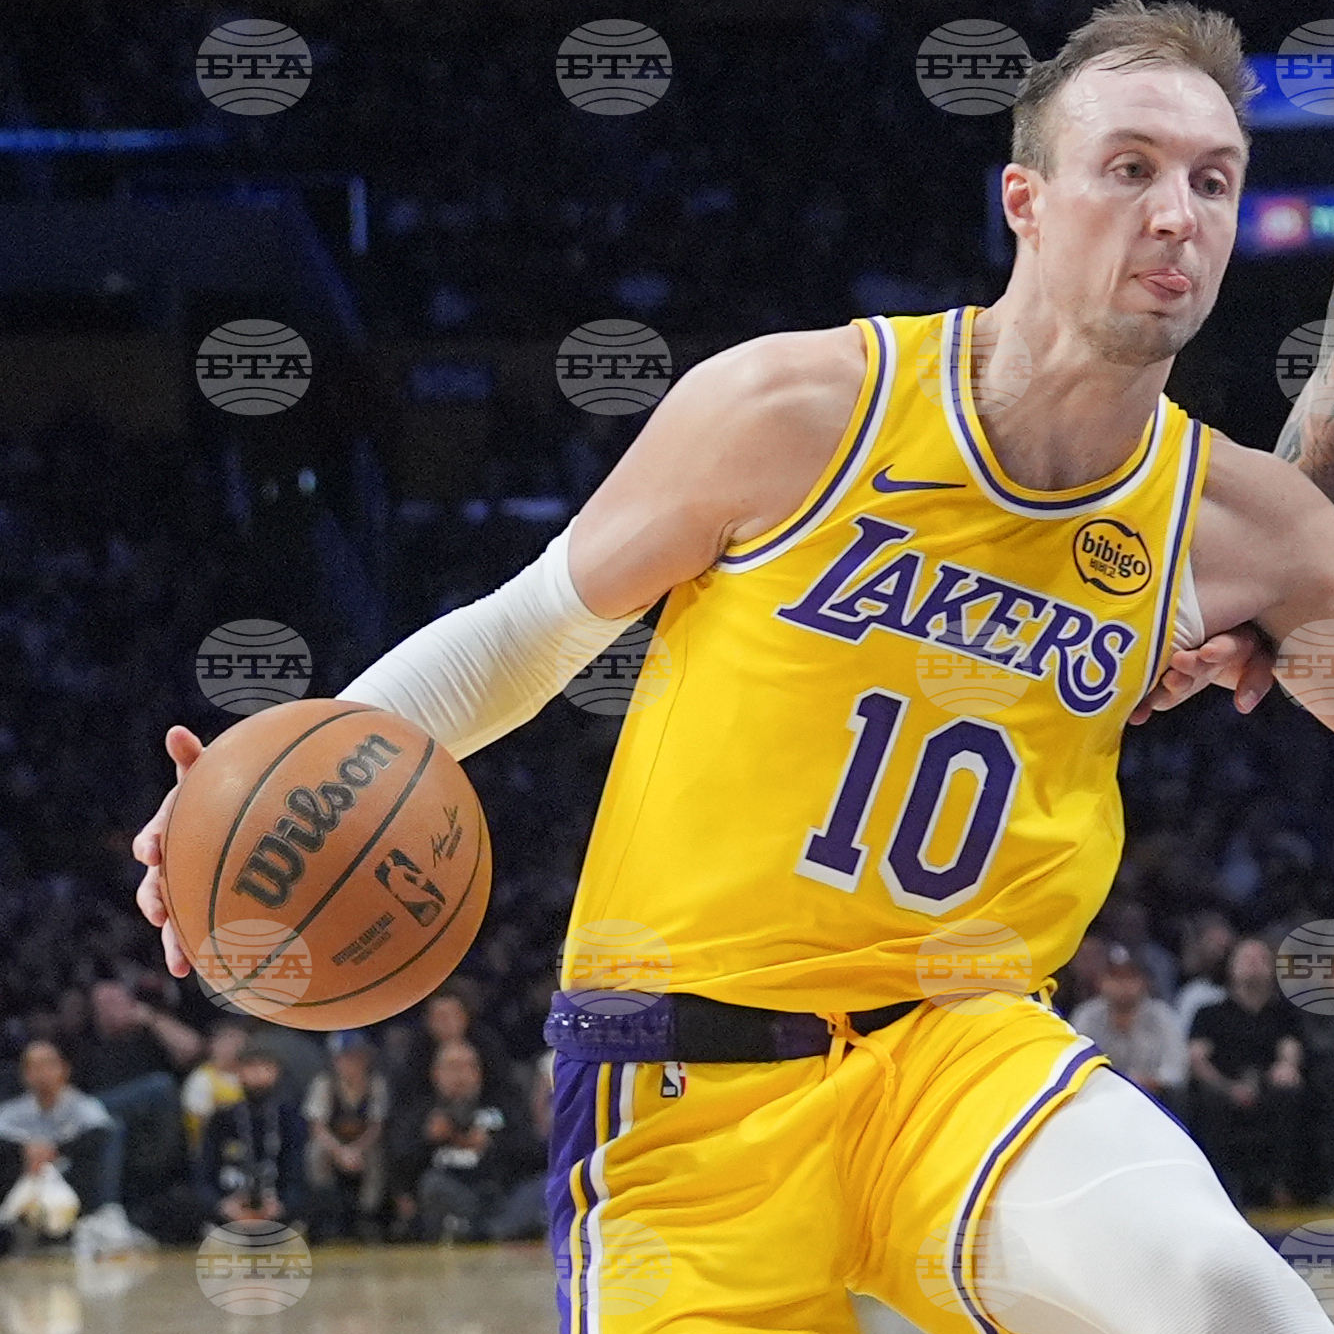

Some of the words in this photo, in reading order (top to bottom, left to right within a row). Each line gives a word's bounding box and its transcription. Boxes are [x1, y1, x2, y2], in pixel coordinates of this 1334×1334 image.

[773, 514, 1139, 717] LAKERS
[1082, 531, 1146, 578] bibigo
[231, 733, 403, 909] Wilson
[794, 685, 1024, 916] 10
